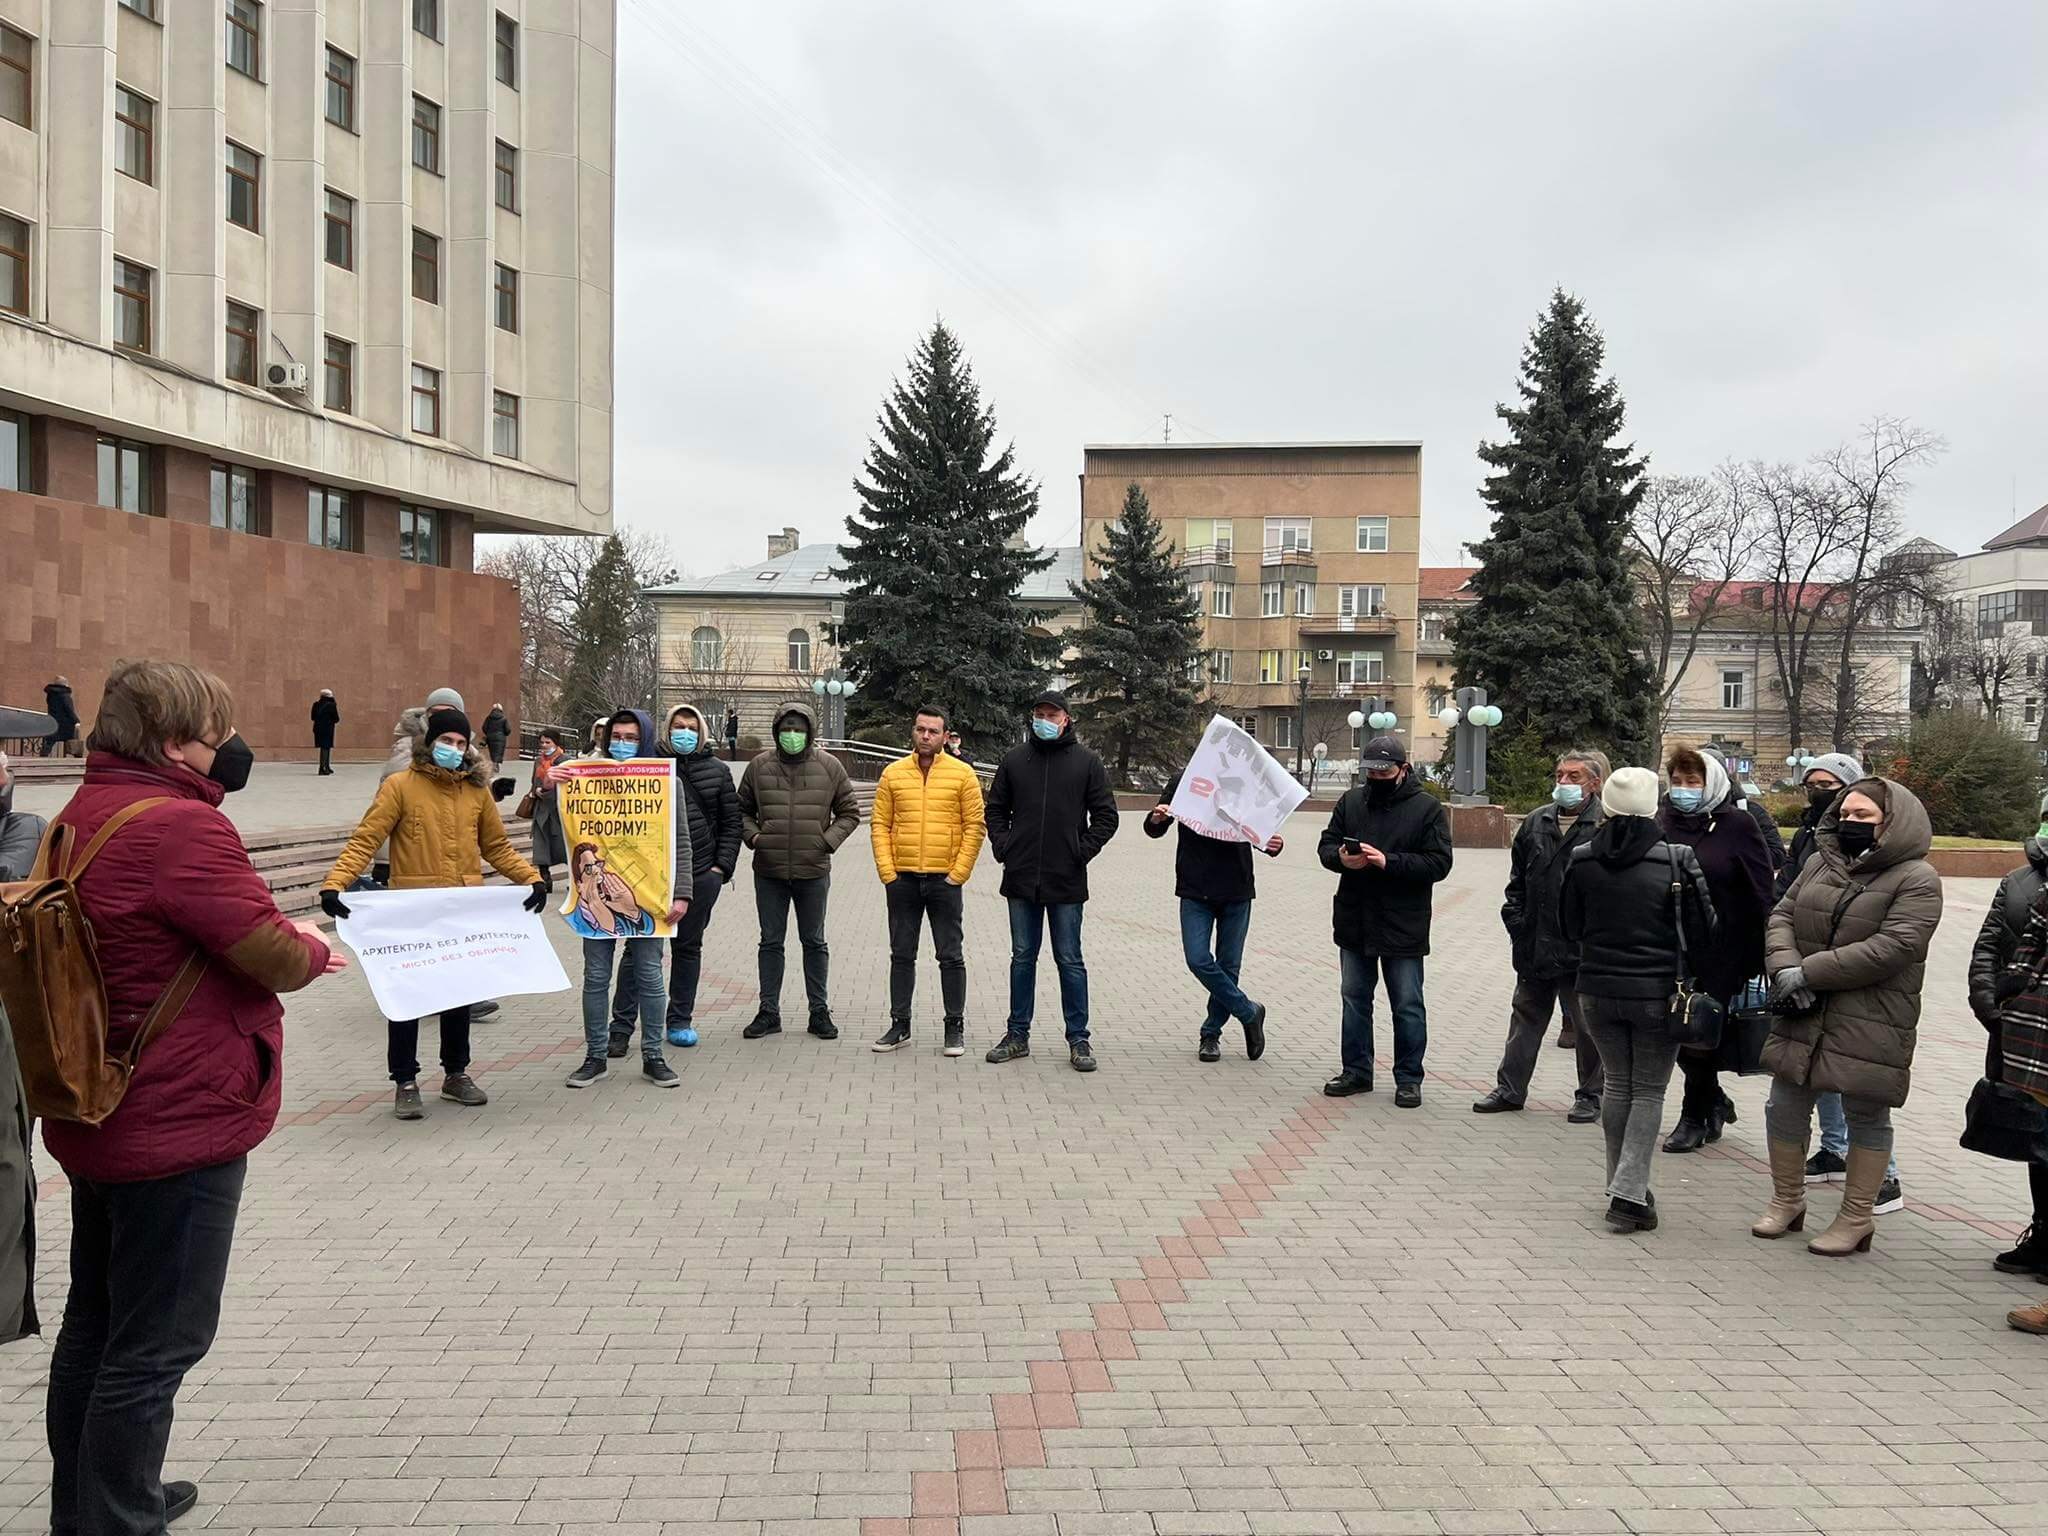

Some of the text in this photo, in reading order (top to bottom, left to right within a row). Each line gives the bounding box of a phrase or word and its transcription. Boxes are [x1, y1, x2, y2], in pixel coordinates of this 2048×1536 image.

[567, 778, 661, 794] ЗА СПРАВЖНЮ
[566, 799, 663, 817] МІСТОБУДІВНУ
[579, 820, 647, 836] РЕФОРМУ!
[362, 932, 530, 956] АРХІТЕКТУРА БЕЗ АРХІТЕКТОРА
[401, 958, 436, 969] МІСТО
[441, 953, 463, 962] БЕЗ
